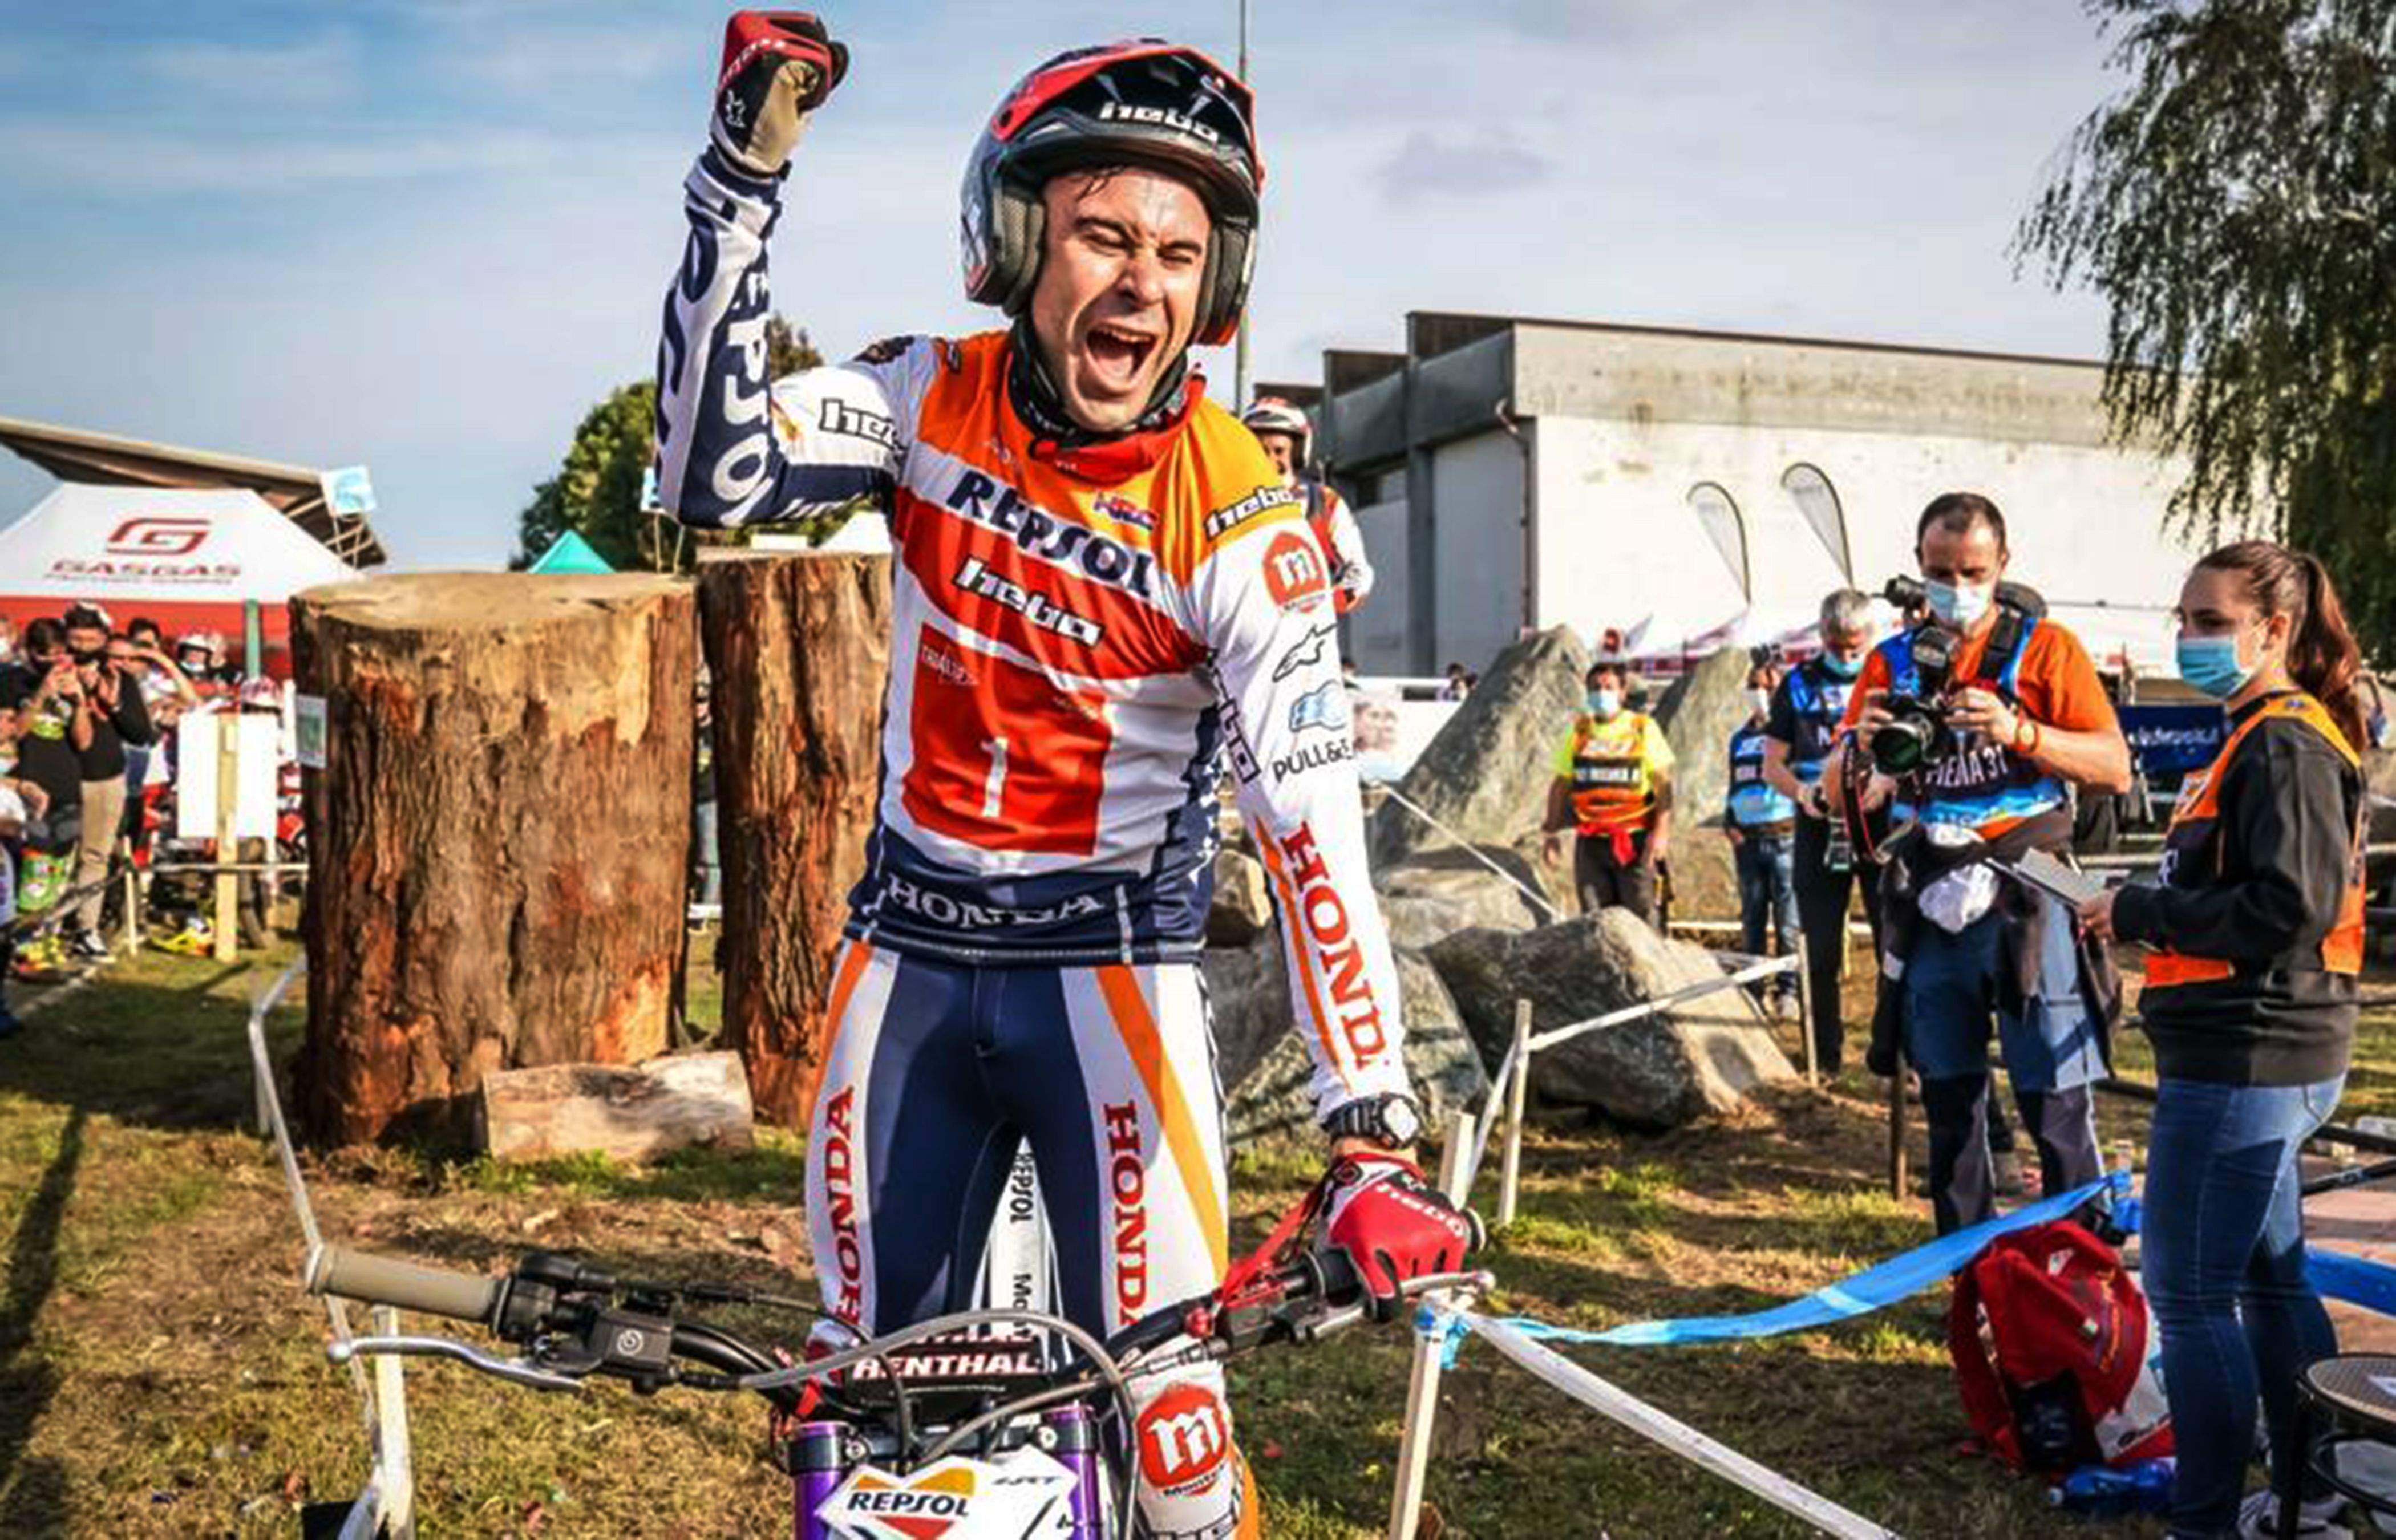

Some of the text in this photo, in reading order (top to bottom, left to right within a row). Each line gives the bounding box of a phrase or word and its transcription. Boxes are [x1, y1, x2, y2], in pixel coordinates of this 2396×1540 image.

[52, 559, 242, 576] GASGAS
[953, 555, 1107, 647] hebo
[981, 736, 1009, 818] 1
[888, 872, 1106, 929] HONDA
[1278, 820, 1391, 1072] HOND
[847, 1490, 970, 1517] REPSOL
